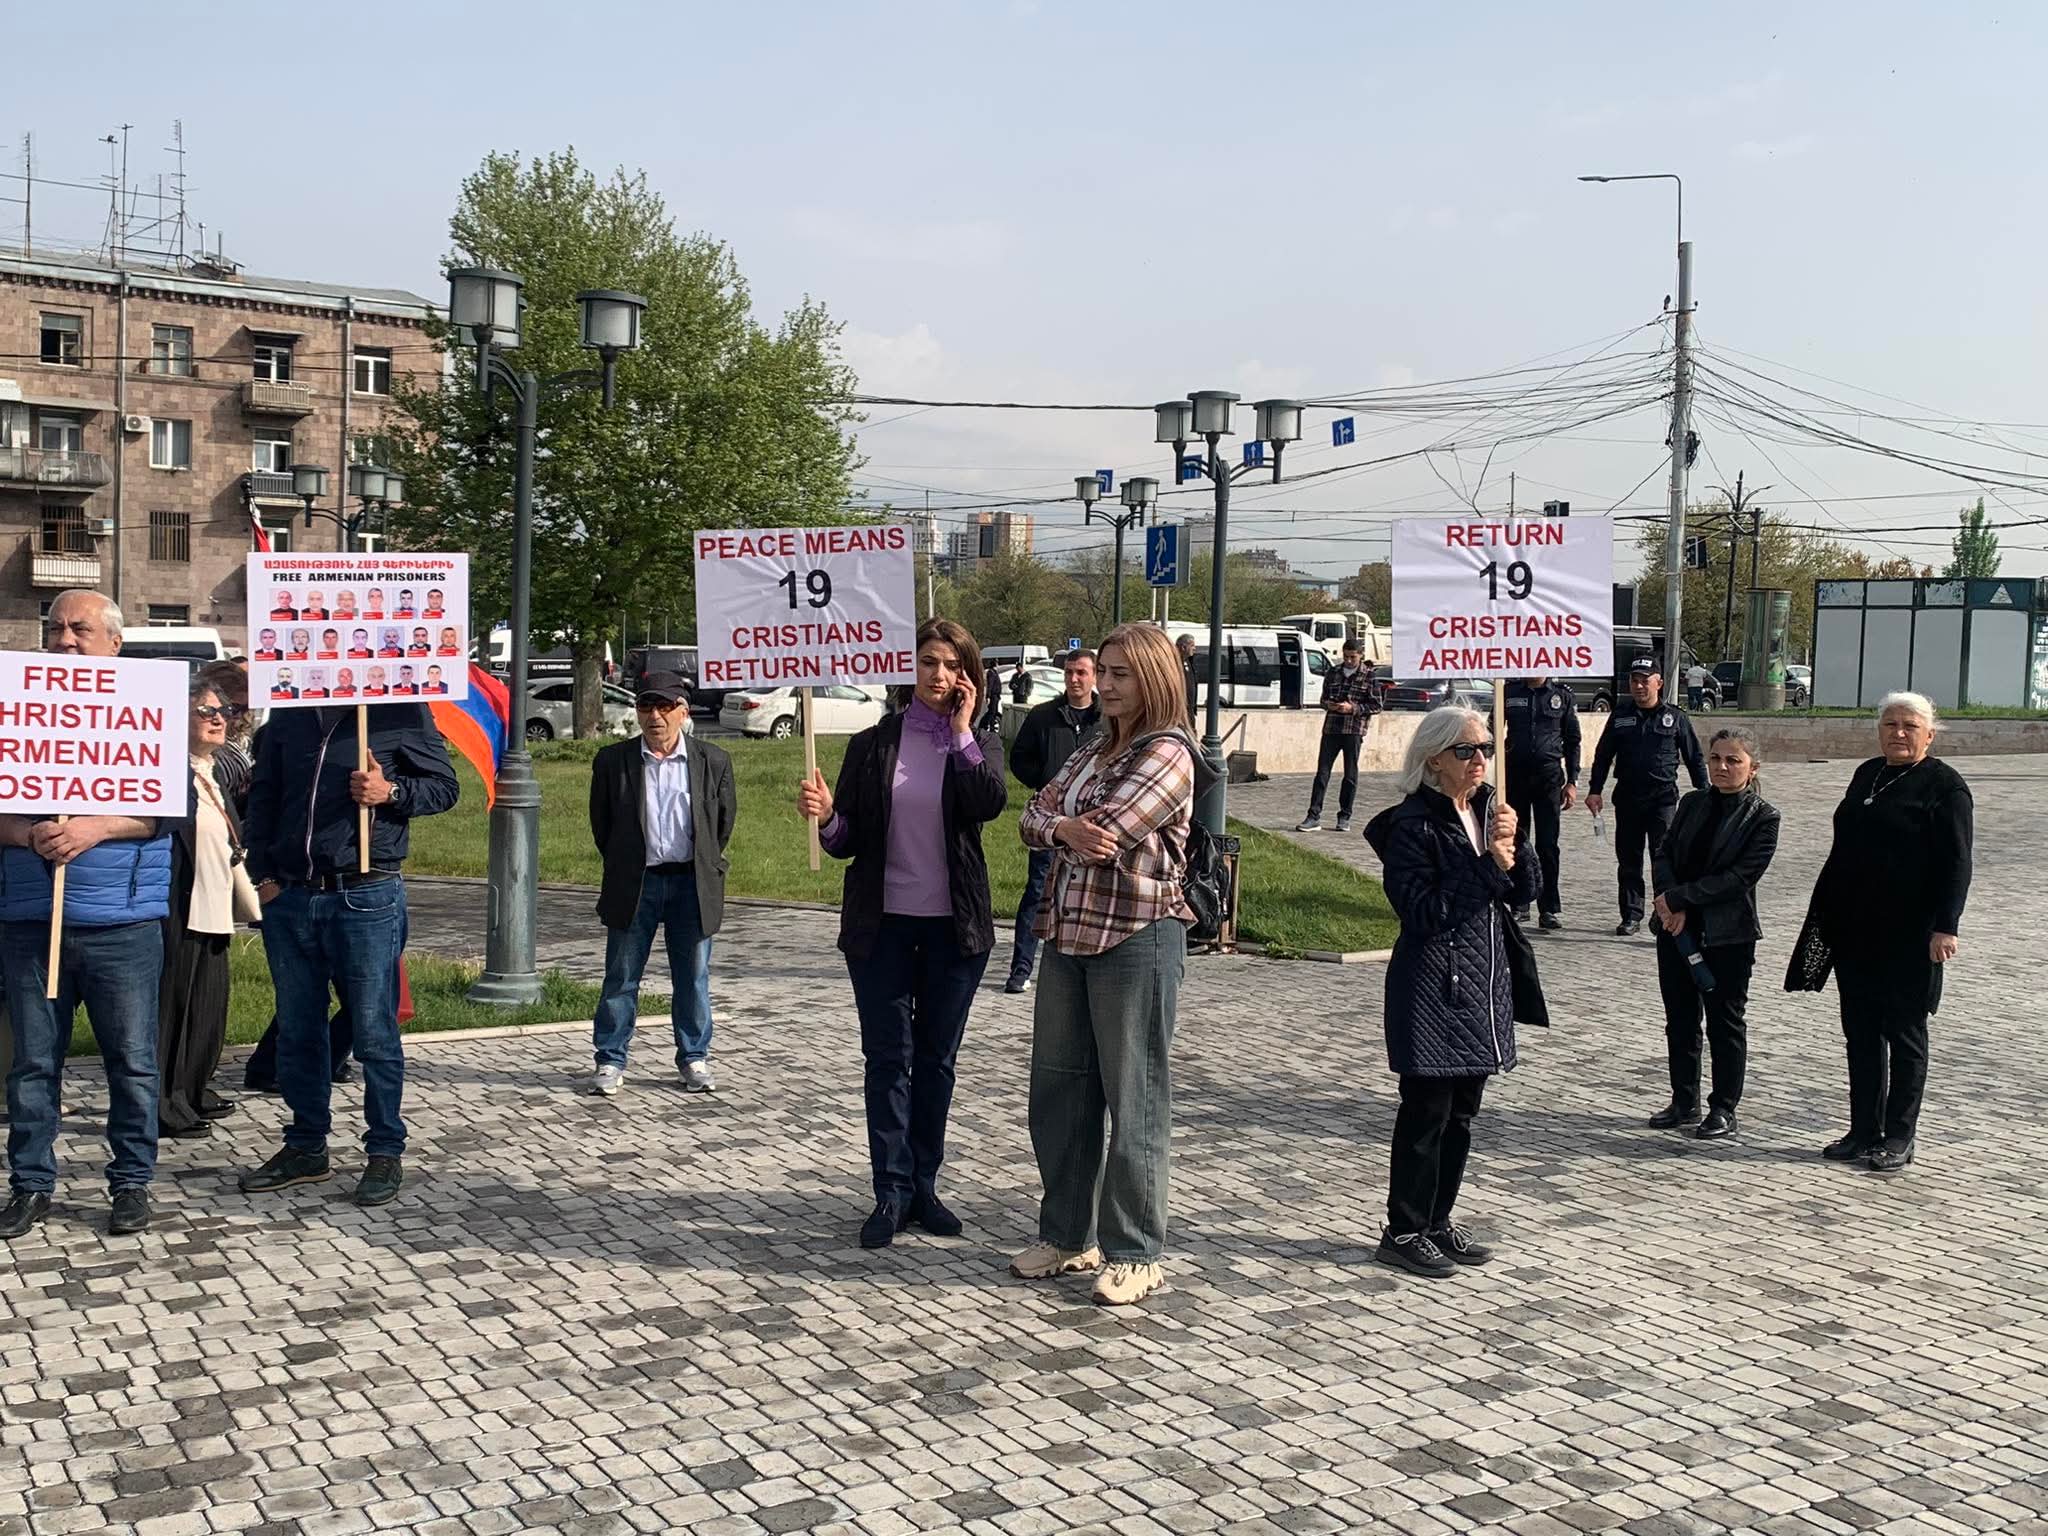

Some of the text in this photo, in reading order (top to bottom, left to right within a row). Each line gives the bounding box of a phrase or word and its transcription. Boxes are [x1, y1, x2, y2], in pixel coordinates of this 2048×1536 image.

[699, 527, 905, 560] PEACE MEANS
[1446, 523, 1564, 547] RETURN
[272, 572, 446, 582] FREE ARMENIAN PRISONERS
[778, 569, 833, 610] 19
[1479, 560, 1533, 601] 19
[732, 620, 883, 650] CRISTIANS
[1429, 614, 1583, 639] CRISTIANS
[704, 650, 914, 683] RETURN HOME
[1419, 646, 1593, 672] ARMENIANS
[24, 665, 116, 694] FREE
[0, 702, 163, 731] HRISTIAN
[0, 738, 161, 767] RMENIAN
[0, 774, 162, 803] OSTAGES
